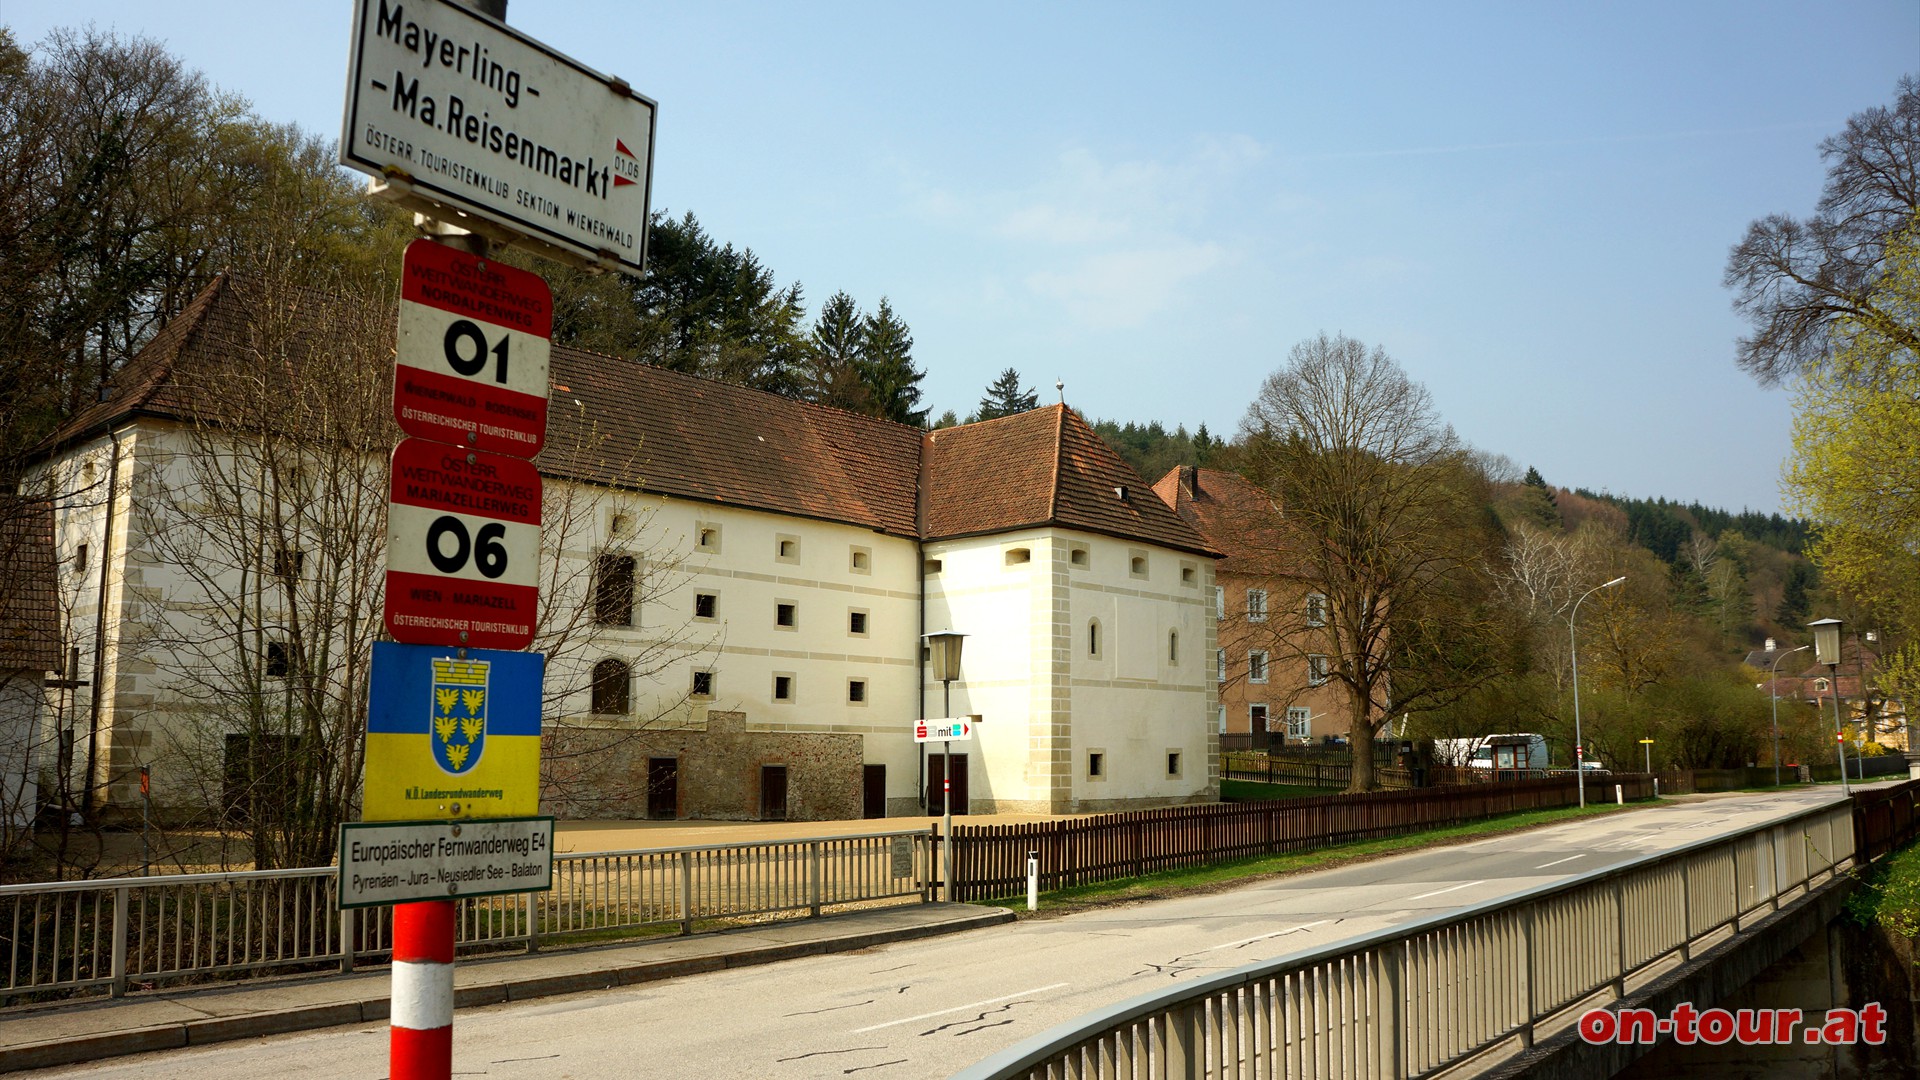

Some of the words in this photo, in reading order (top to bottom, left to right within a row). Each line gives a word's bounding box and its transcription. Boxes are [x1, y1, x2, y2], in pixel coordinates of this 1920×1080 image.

[614, 156, 639, 178] 01.06
[366, 123, 416, 163] ÖSTERR.
[420, 149, 509, 199] TOURISTENKLUB
[516, 189, 559, 219] SEKTION
[566, 208, 632, 249] WIENERWALD
[412, 263, 542, 314] WEITWANDERWEG
[421, 285, 533, 327] NORDALPENWEG
[444, 319, 510, 384] 01
[402, 405, 477, 433] ÖSTERREICHISCHER
[479, 422, 537, 444] TOURISTENKLUB
[402, 465, 534, 501] WEITWANDERWEG
[406, 485, 529, 517] MARIAZELLERWEG
[426, 515, 508, 579] 06
[409, 588, 442, 604] WIEN
[453, 591, 517, 610] MARIAZELL
[393, 612, 469, 631] ÖSTERREICHISCHER
[471, 620, 529, 636] TOURISTENKLUB
[352, 838, 435, 865] Europäischer
[438, 835, 529, 857] Fernwanderweg
[532, 832, 545, 851] E4
[353, 872, 398, 894] Pyrenäen
[408, 870, 428, 886] Jura
[438, 866, 485, 883] Neusiedler
[487, 863, 503, 880] See
[512, 863, 542, 877] Balaton
